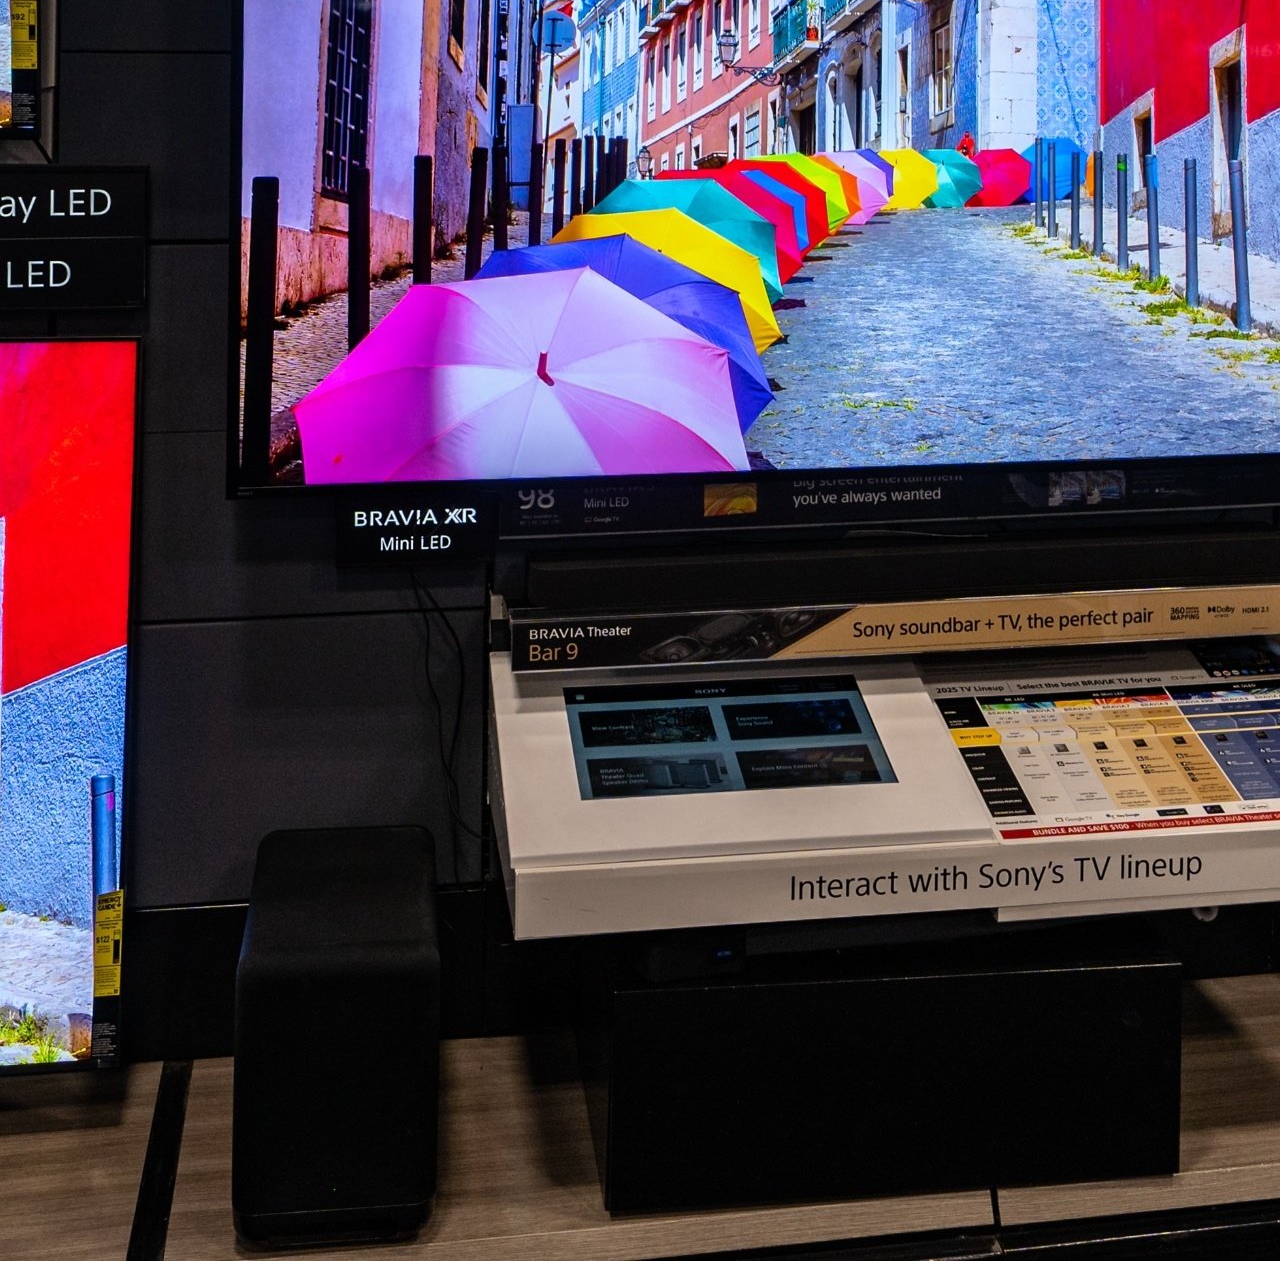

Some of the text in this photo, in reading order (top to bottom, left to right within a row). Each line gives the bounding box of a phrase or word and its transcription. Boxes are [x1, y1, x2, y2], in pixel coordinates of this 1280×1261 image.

[50, 189, 112, 216] LED
[7, 260, 71, 288] LED
[584, 497, 630, 509] Mini LED
[793, 487, 941, 508] you've always wanted
[354, 508, 477, 527] BRAVIA XR
[593, 516, 612, 524] Google
[380, 535, 451, 551] Mini LED
[1170, 607, 1184, 615] 360
[1217, 606, 1236, 615] Dolby
[853, 608, 1154, 640] Sony soundbar + TV, the perfect pair
[529, 626, 632, 640] BRAVIA Theater
[529, 643, 579, 662] Bar 9
[936, 686, 958, 694] 2025
[1081, 678, 1115, 686] BRAVIA
[1032, 827, 1067, 836] BUNDLE
[1068, 826, 1087, 834] AND
[1089, 825, 1109, 833] SAVE
[1109, 824, 1129, 832] $100
[1135, 821, 1159, 829] When
[1173, 819, 1190, 827] buy
[1214, 815, 1244, 823] BRAVIA
[1244, 813, 1273, 821] Theater
[790, 853, 1203, 901] Interact with Sony's TV lineup
